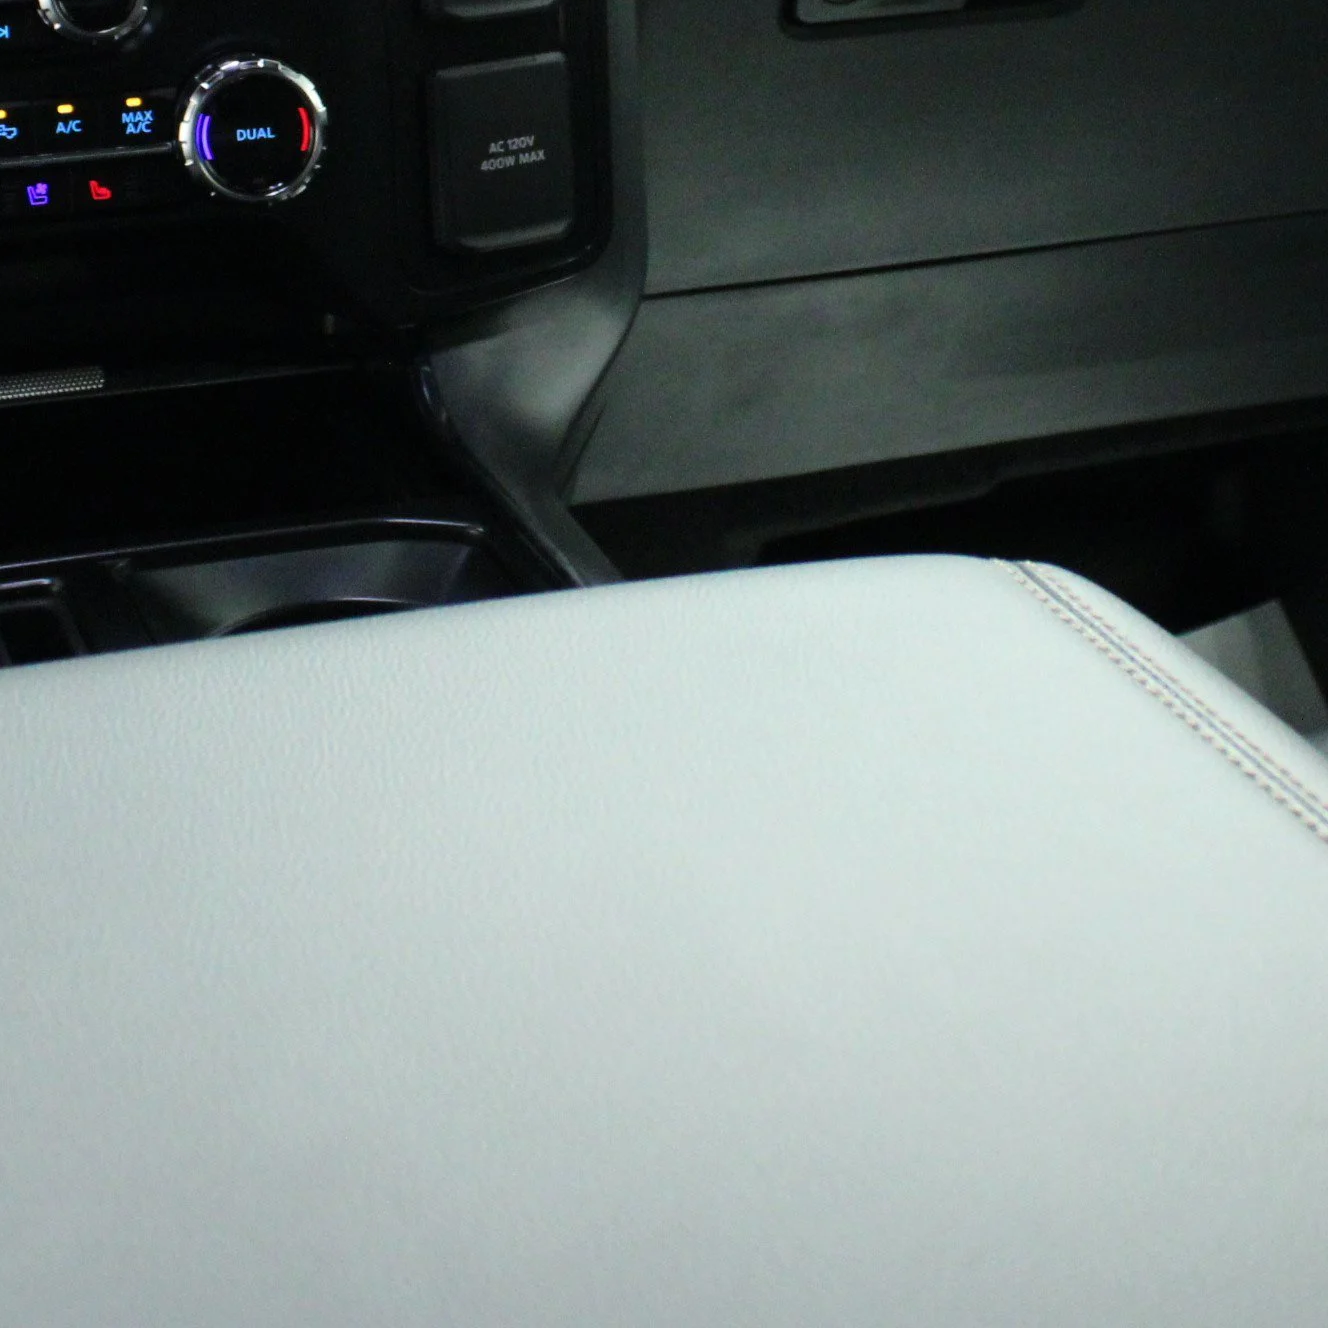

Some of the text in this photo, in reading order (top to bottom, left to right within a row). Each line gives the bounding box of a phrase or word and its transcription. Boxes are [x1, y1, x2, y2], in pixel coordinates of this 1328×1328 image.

[122, 109, 154, 124] MAX
[56, 119, 82, 135] A/C
[126, 121, 152, 136] A/C
[236, 128, 276, 143] DUAL
[489, 140, 505, 155] AC
[480, 149, 546, 172] 400W MAX
